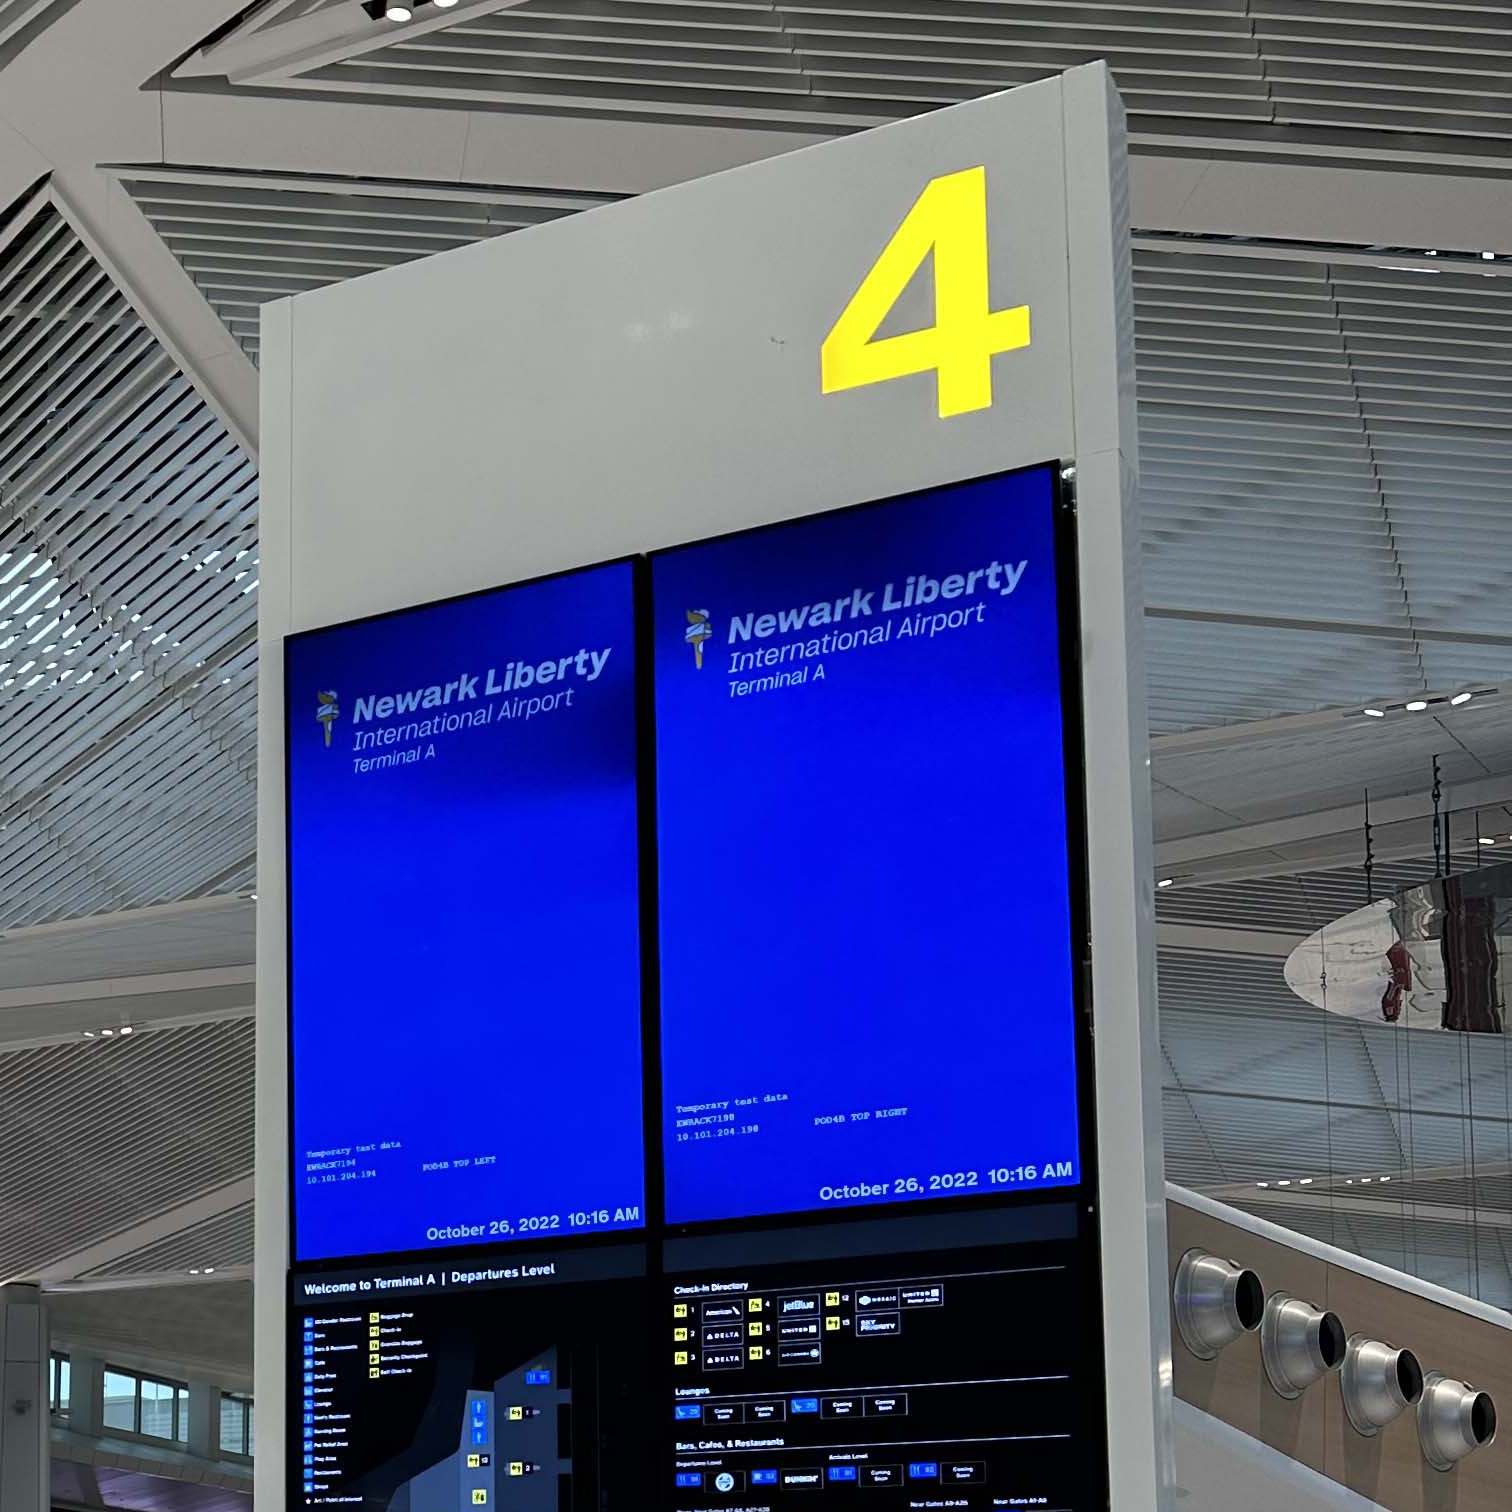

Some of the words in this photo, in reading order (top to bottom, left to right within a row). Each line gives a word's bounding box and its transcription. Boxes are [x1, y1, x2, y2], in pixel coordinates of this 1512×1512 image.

[821, 164, 1030, 419] 4
[727, 588, 875, 644] Newark
[881, 559, 1029, 613] Liberty
[727, 619, 892, 674] International
[896, 600, 986, 639] Airport
[352, 671, 480, 724] Newark
[484, 647, 612, 696] Liberty
[728, 666, 808, 698] Terminal
[812, 663, 826, 681] A
[352, 703, 493, 752] International
[497, 687, 575, 721] Airport
[353, 746, 421, 774] Terminal
[424, 743, 436, 759] A
[675, 1100, 729, 1114] Temporary
[734, 1095, 759, 1106] test
[763, 1092, 789, 1103] data
[851, 1111, 871, 1122] TOP
[875, 1107, 908, 1119] RIGHT
[306, 1147, 352, 1160] Temporary
[355, 1142, 376, 1153] test
[380, 1140, 402, 1150] data
[453, 1158, 471, 1169] TOP
[474, 1155, 497, 1166] LEFT
[819, 1180, 890, 1201] October
[894, 1178, 925, 1195] 26,
[929, 1170, 978, 1191] 2022
[987, 1165, 1038, 1185] 10:16
[1042, 1161, 1073, 1179] AM
[426, 1224, 486, 1241] October
[489, 1220, 516, 1236] 26,
[518, 1215, 561, 1232] 2022
[567, 1210, 610, 1228] 10:16
[613, 1206, 640, 1223] AM
[304, 1280, 357, 1297] Welcome
[359, 1279, 372, 1291] to
[374, 1274, 424, 1290] Terminal
[426, 1273, 437, 1286] A
[451, 1267, 519, 1284] Departures
[521, 1263, 556, 1277] Level
[674, 1283, 709, 1295] Check-in
[711, 1281, 749, 1294] Directory
[782, 1300, 815, 1312] jetBlue
[714, 1331, 740, 1340] DELTA
[714, 1355, 740, 1363] DELTA
[674, 1386, 710, 1396] Lounges
[675, 1442, 697, 1452] Bars,
[727, 1440, 734, 1449] &
[735, 1437, 785, 1448] Restaurants
